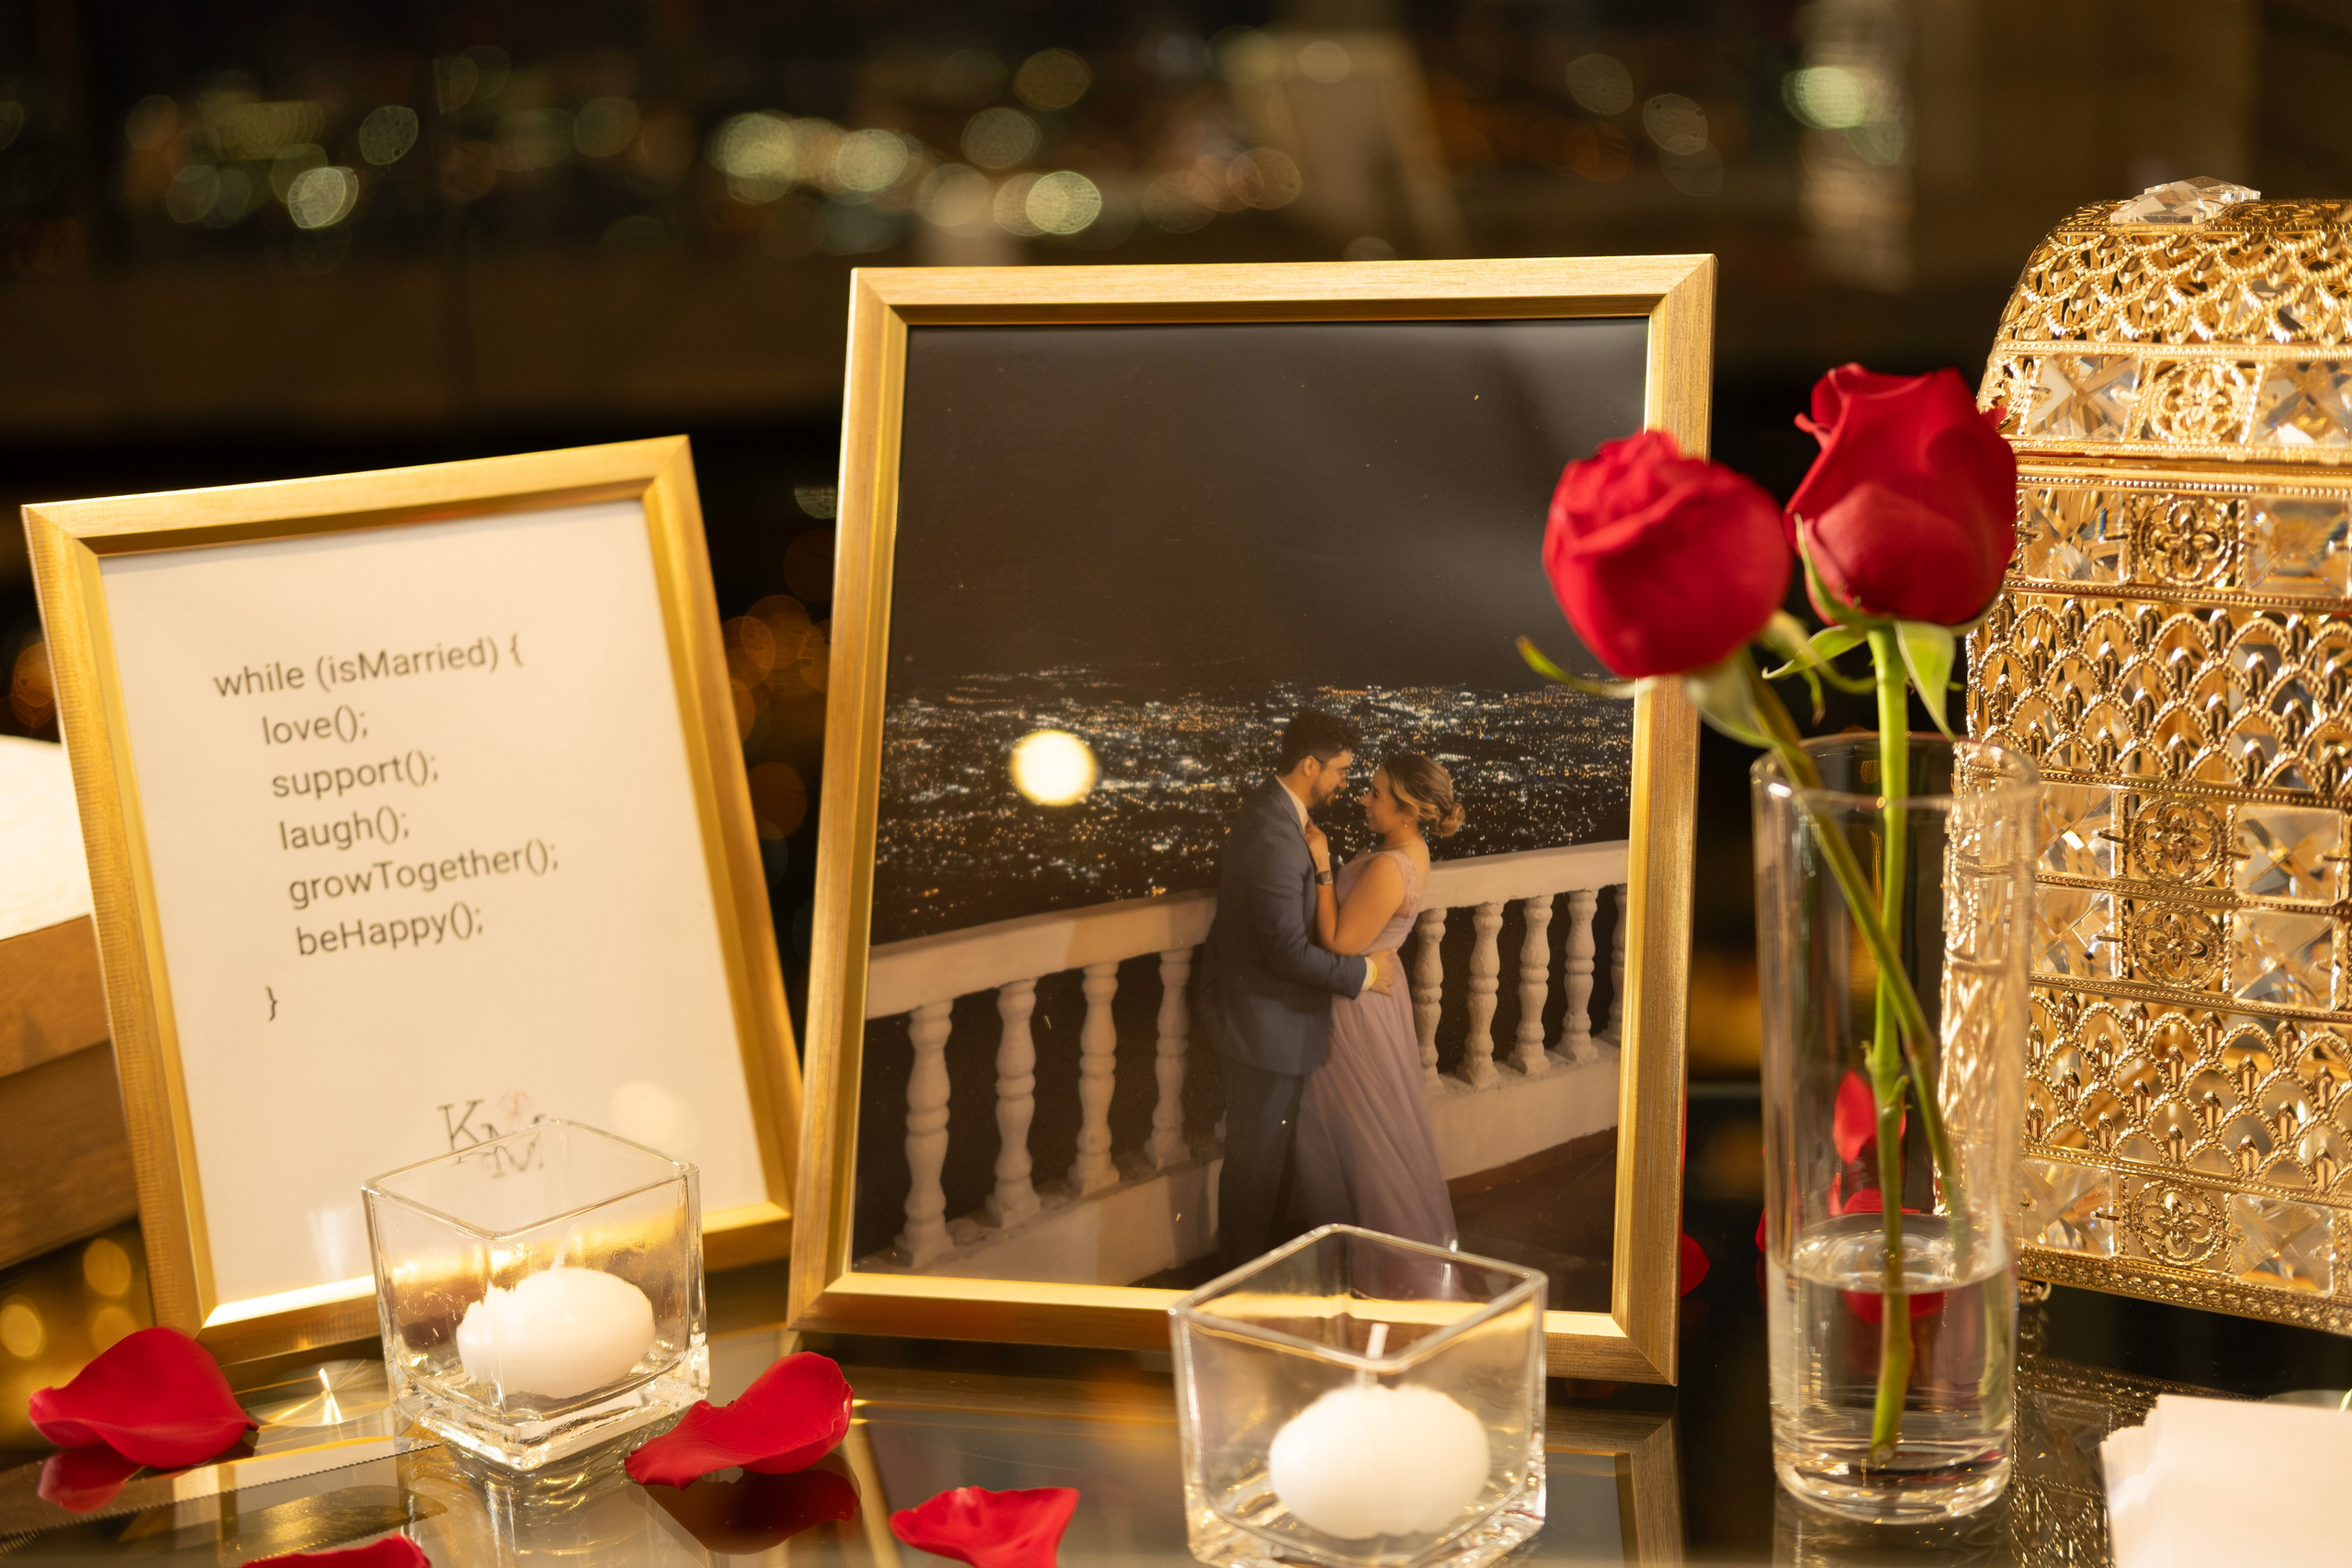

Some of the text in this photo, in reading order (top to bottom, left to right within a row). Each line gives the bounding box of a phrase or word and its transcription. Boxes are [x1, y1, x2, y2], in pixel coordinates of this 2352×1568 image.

[213, 632, 524, 698] while (isMarried) {
[262, 705, 368, 745] love();
[271, 750, 438, 800] support();
[278, 806, 410, 851] laugh();
[288, 839, 559, 910] growTogether();
[296, 901, 483, 957] beHappy();
